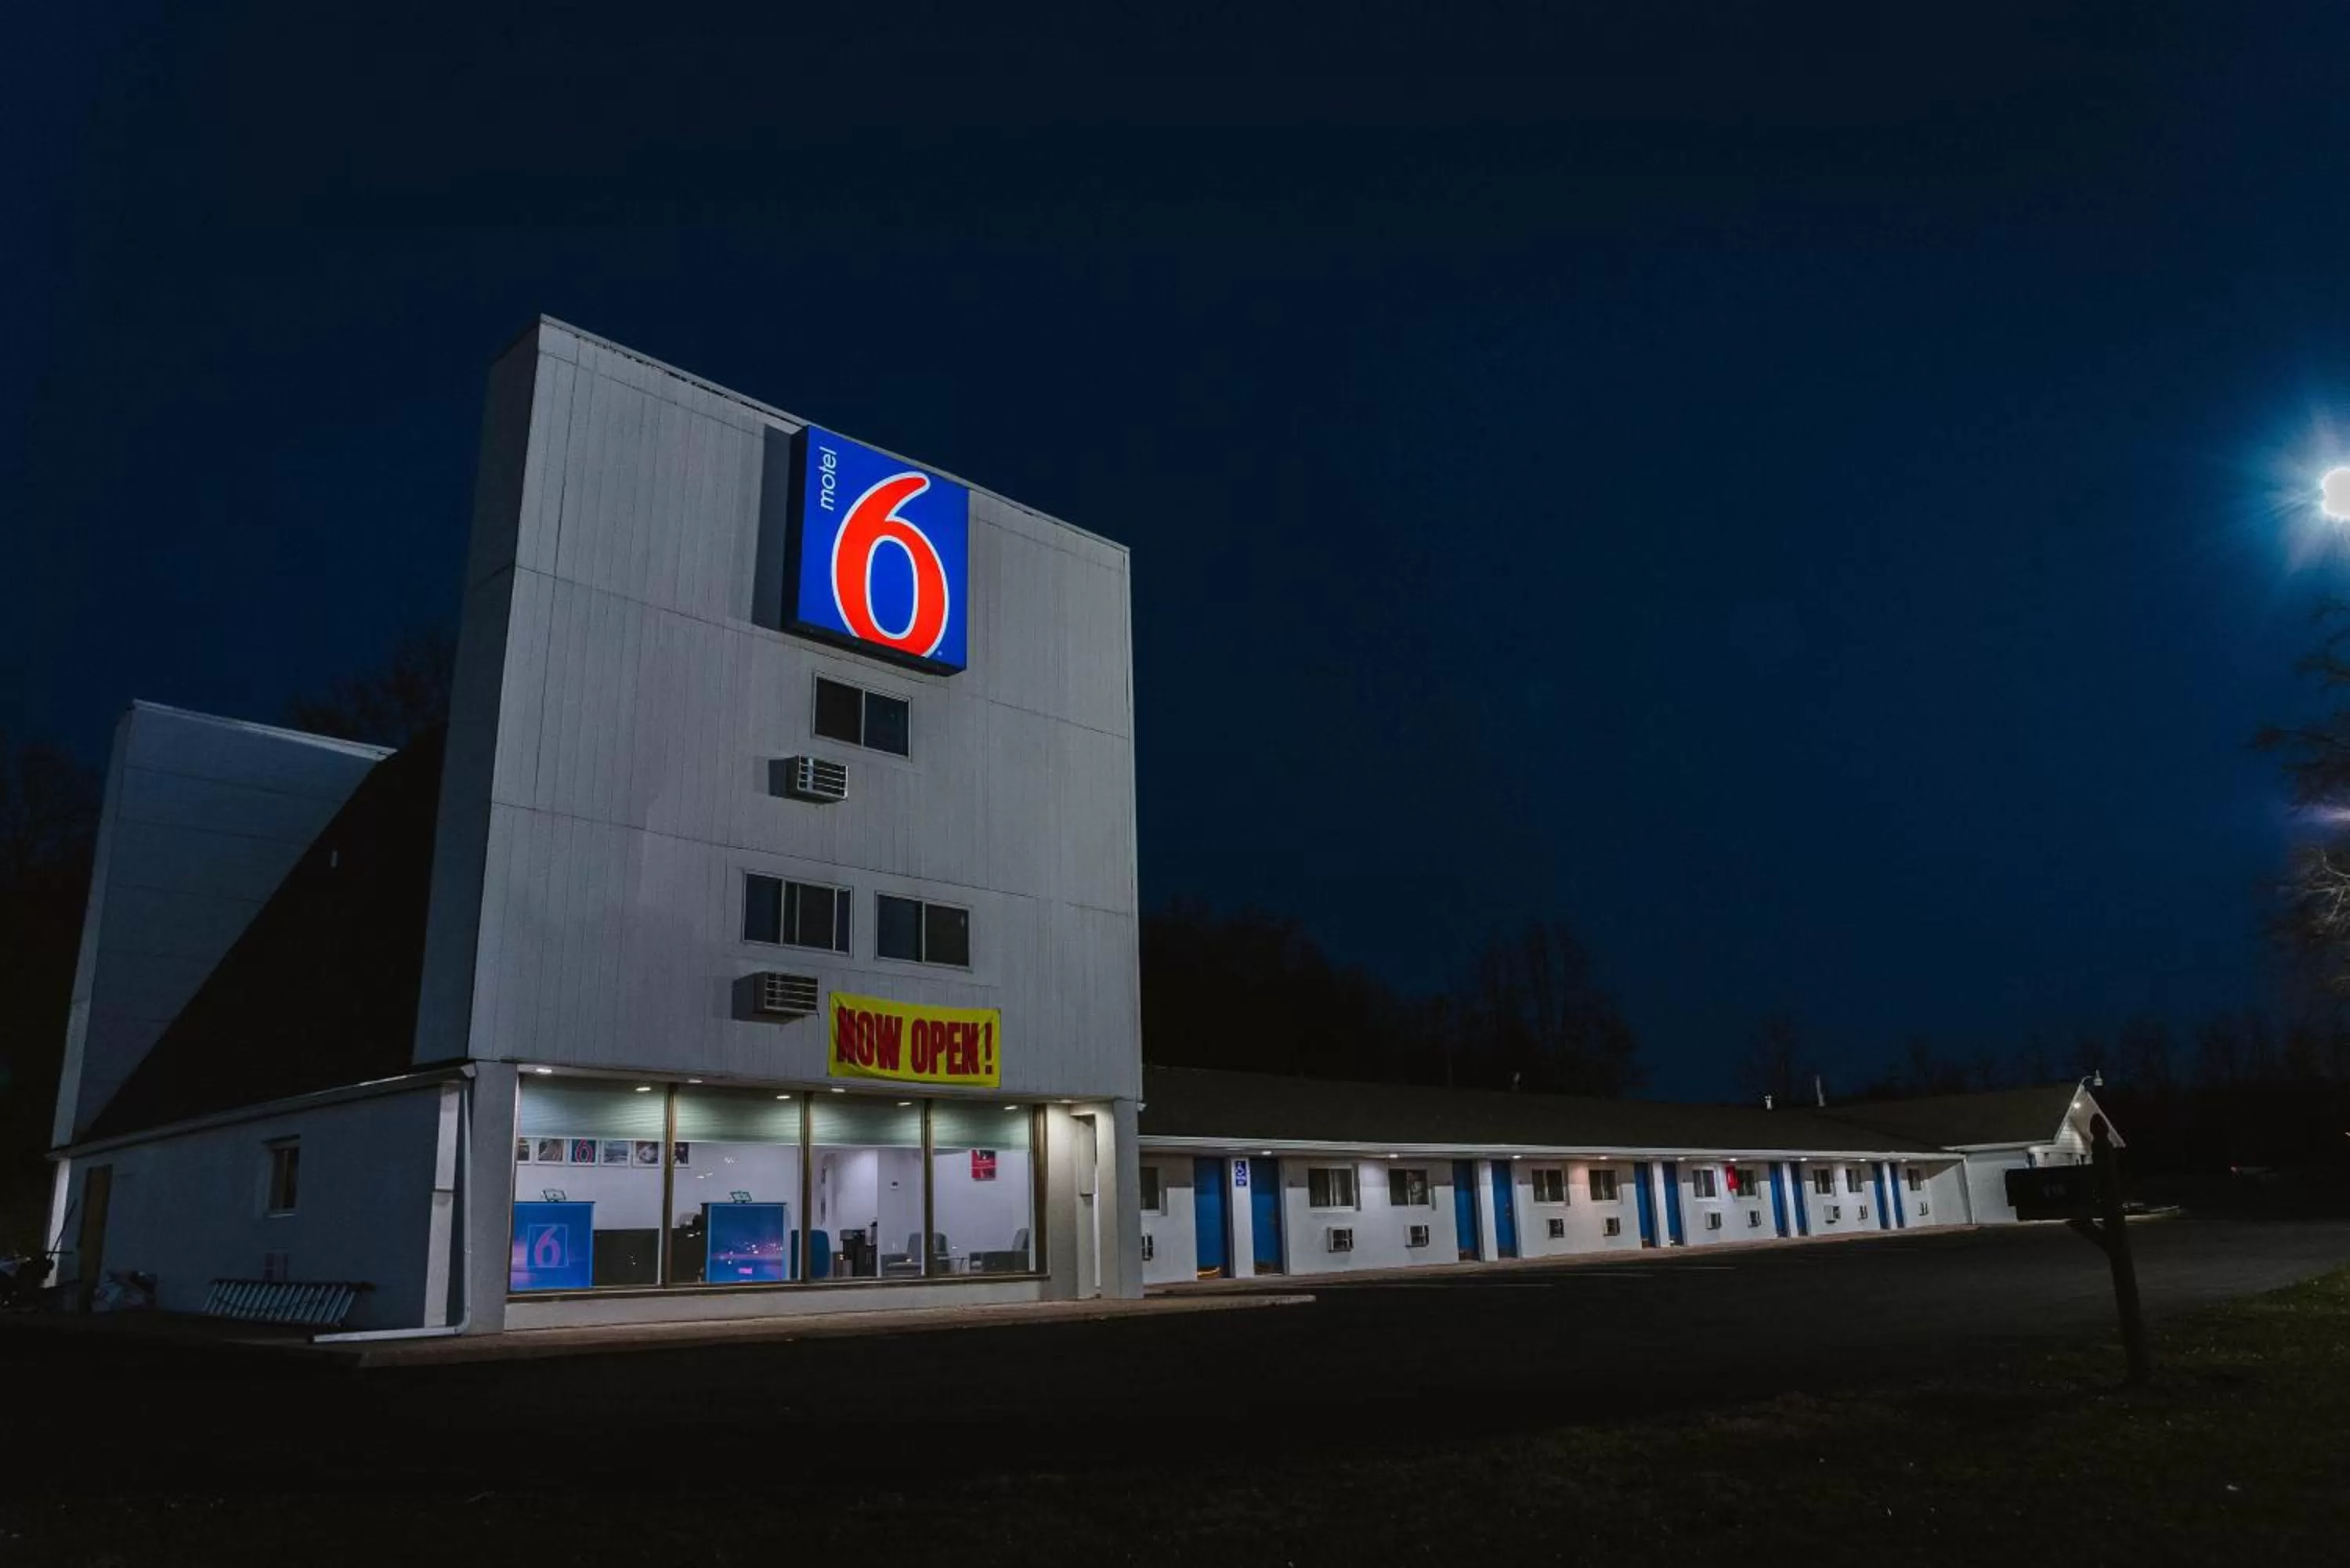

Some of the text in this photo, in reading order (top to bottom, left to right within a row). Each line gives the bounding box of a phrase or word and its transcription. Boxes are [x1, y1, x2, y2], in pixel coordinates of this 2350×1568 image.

[819, 446, 837, 511] motel
[832, 471, 949, 658] 6
[837, 1006, 993, 1075] NOW OPEN!
[534, 1224, 560, 1268] 6
